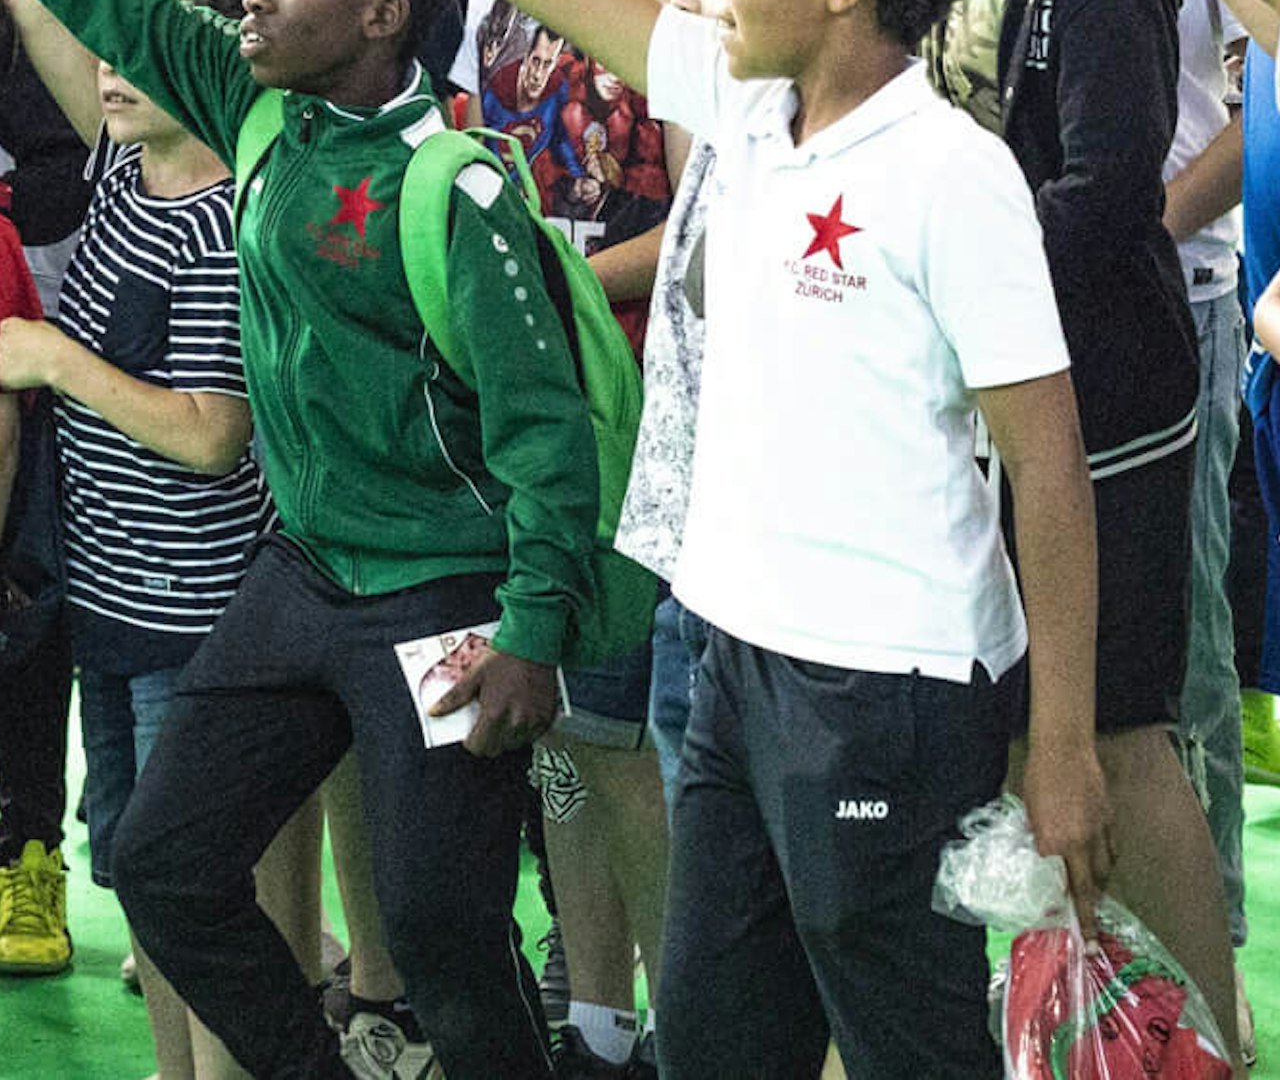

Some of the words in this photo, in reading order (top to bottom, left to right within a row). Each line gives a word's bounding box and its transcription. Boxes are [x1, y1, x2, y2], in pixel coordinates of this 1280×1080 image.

[804, 264, 828, 282] RED
[832, 271, 867, 290] STAR
[835, 800, 889, 820] JAKO
